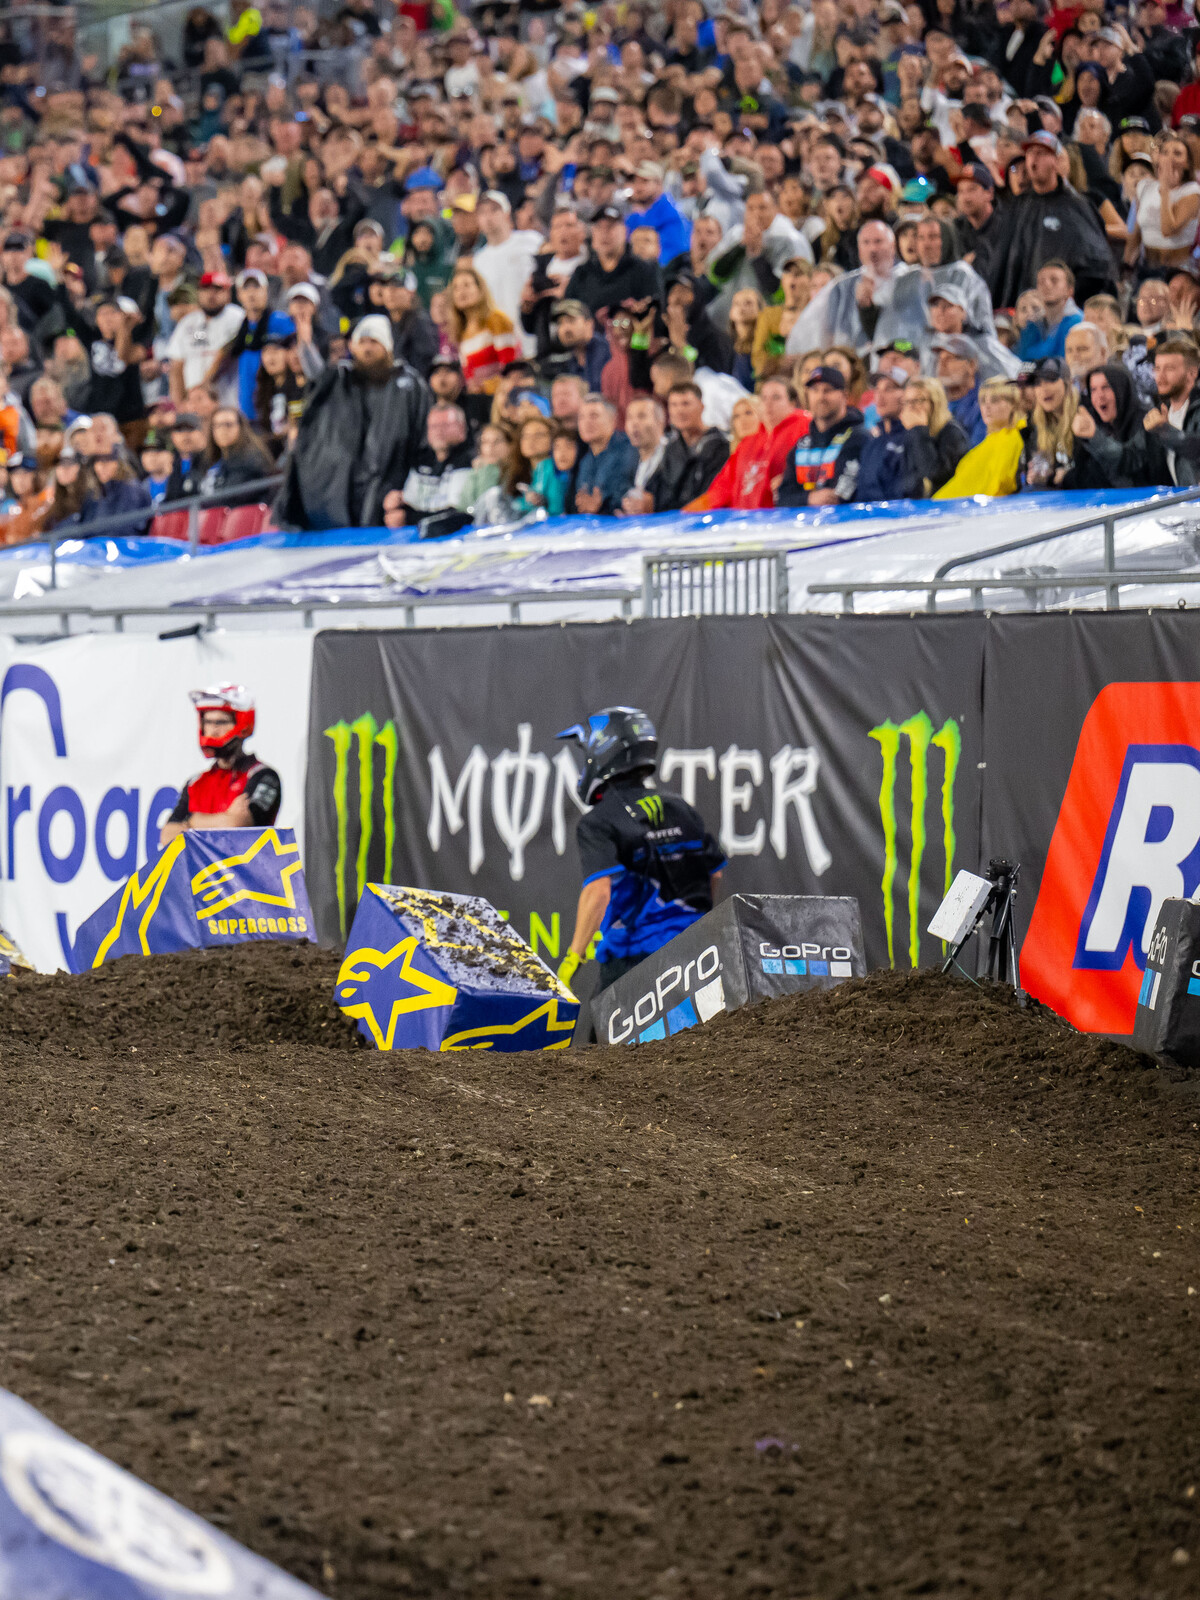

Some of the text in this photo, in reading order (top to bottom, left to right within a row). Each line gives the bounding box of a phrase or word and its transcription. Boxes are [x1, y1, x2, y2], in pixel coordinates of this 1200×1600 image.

[427, 722, 833, 881] MONTER
[1084, 762, 1200, 953] R
[207, 915, 308, 935] SUPERCROSS
[759, 942, 852, 961] GoPro
[608, 944, 720, 1046] GoPro
